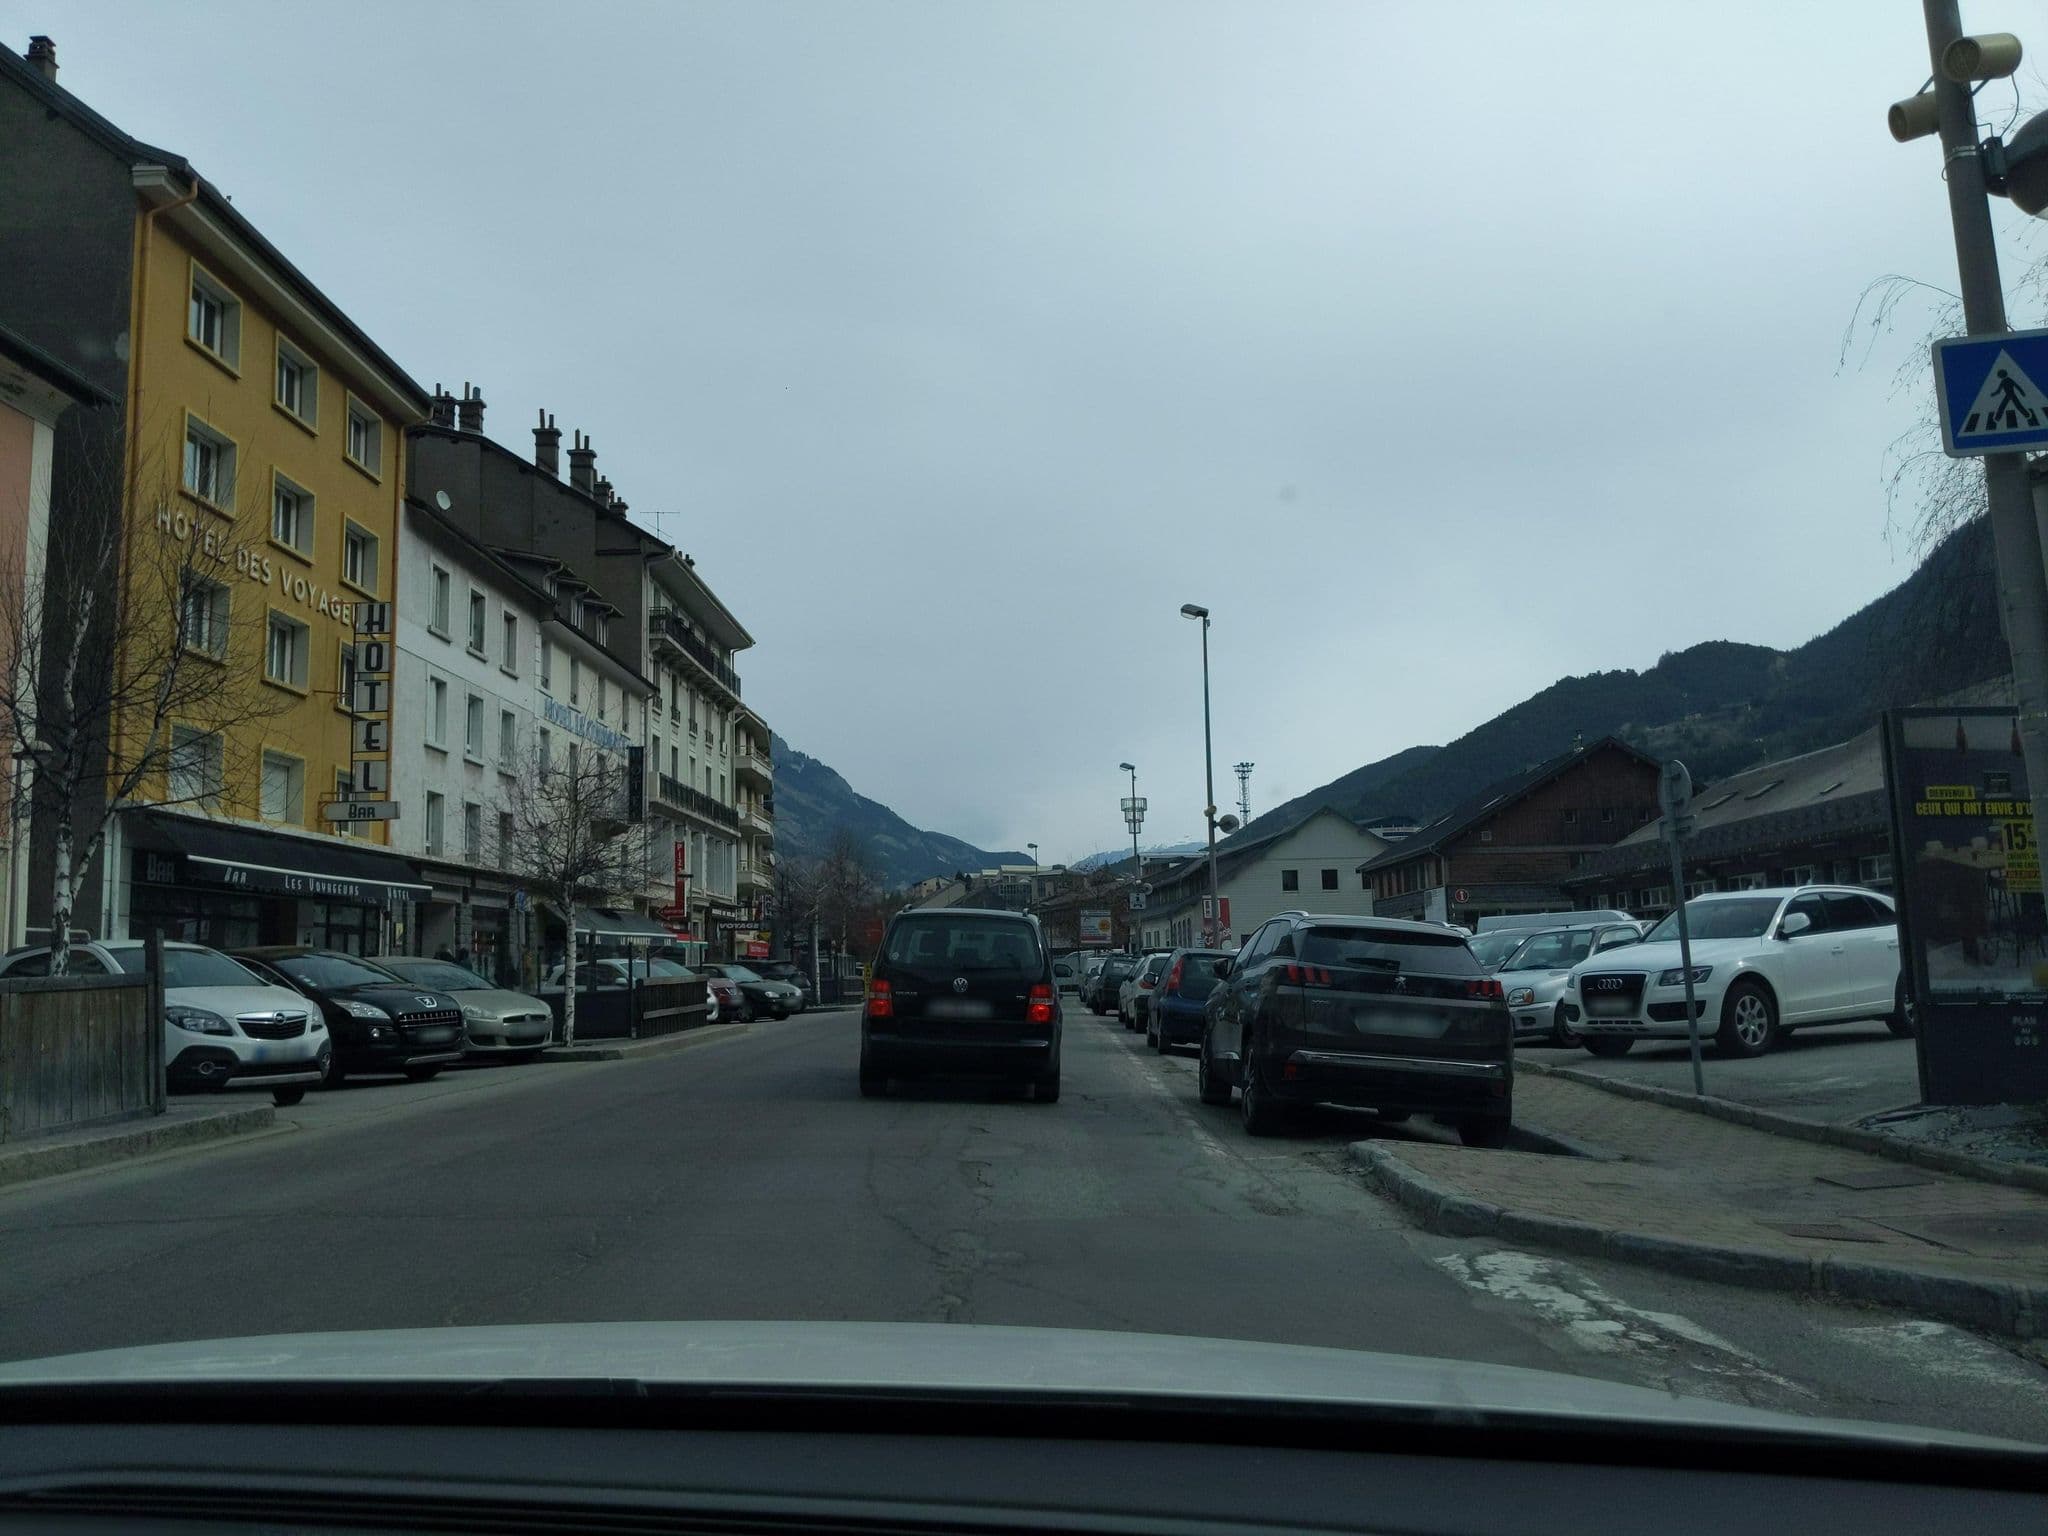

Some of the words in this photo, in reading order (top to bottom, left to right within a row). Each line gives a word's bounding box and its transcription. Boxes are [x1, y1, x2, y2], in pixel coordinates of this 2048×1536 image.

[237, 547, 272, 585] DES
[280, 566, 357, 626] VOYAGE
[364, 603, 386, 791] HOTEL
[349, 803, 376, 819] BAR
[1915, 801, 1941, 816] CEUX
[1944, 801, 1960, 817] QUI
[1963, 801, 1982, 816] ONT
[1985, 801, 2014, 816] ENVIE
